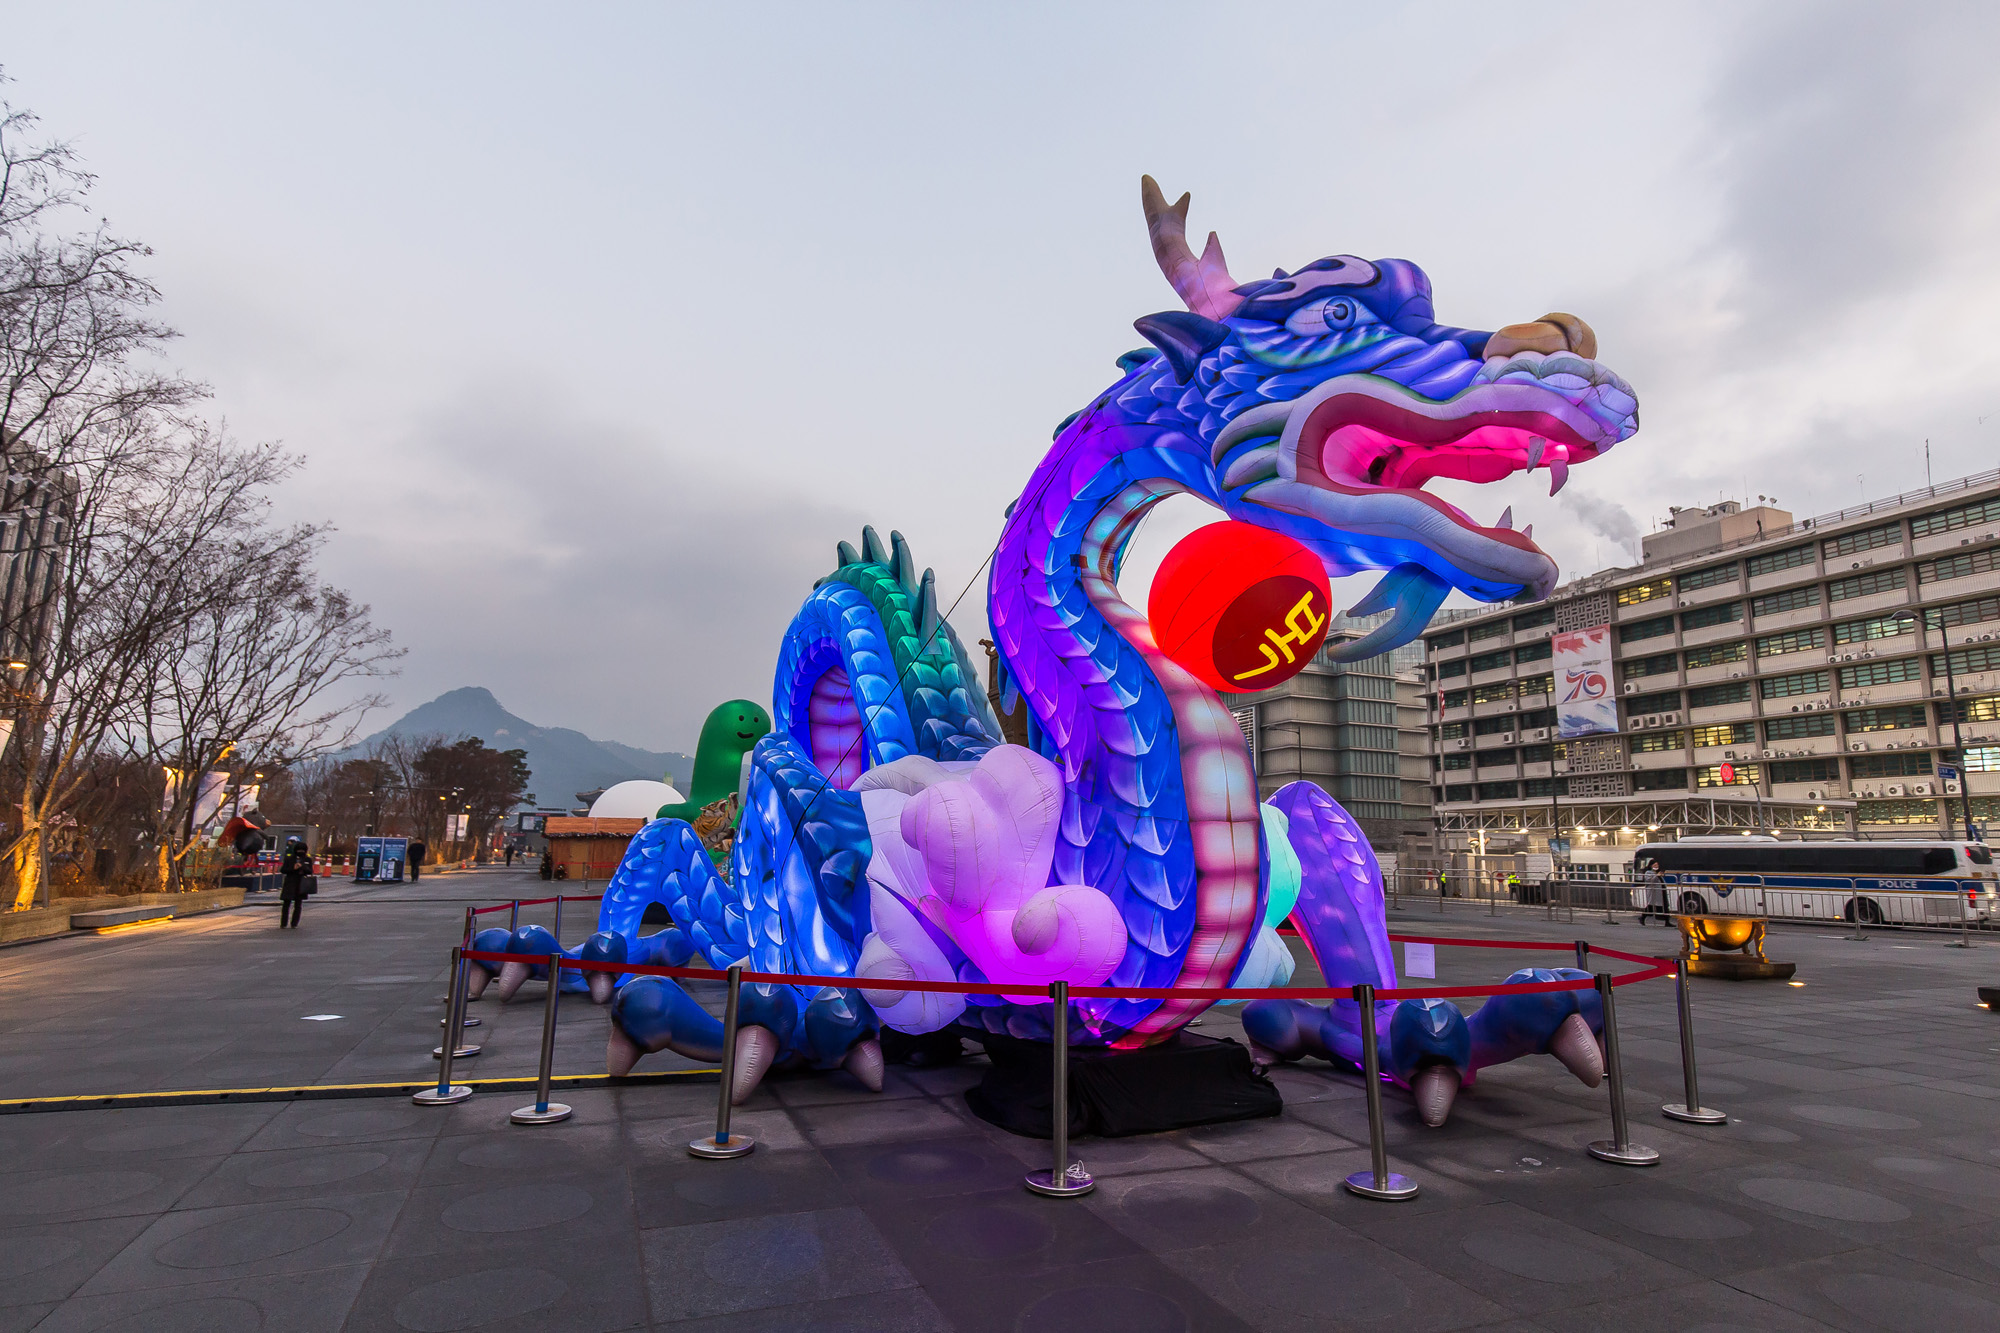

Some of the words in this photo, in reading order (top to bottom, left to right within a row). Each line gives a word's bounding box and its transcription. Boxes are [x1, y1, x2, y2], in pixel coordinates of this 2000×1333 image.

[1233, 590, 1325, 681] 복
[1562, 669, 1607, 705] 70
[1878, 880, 1918, 889] POLICE
